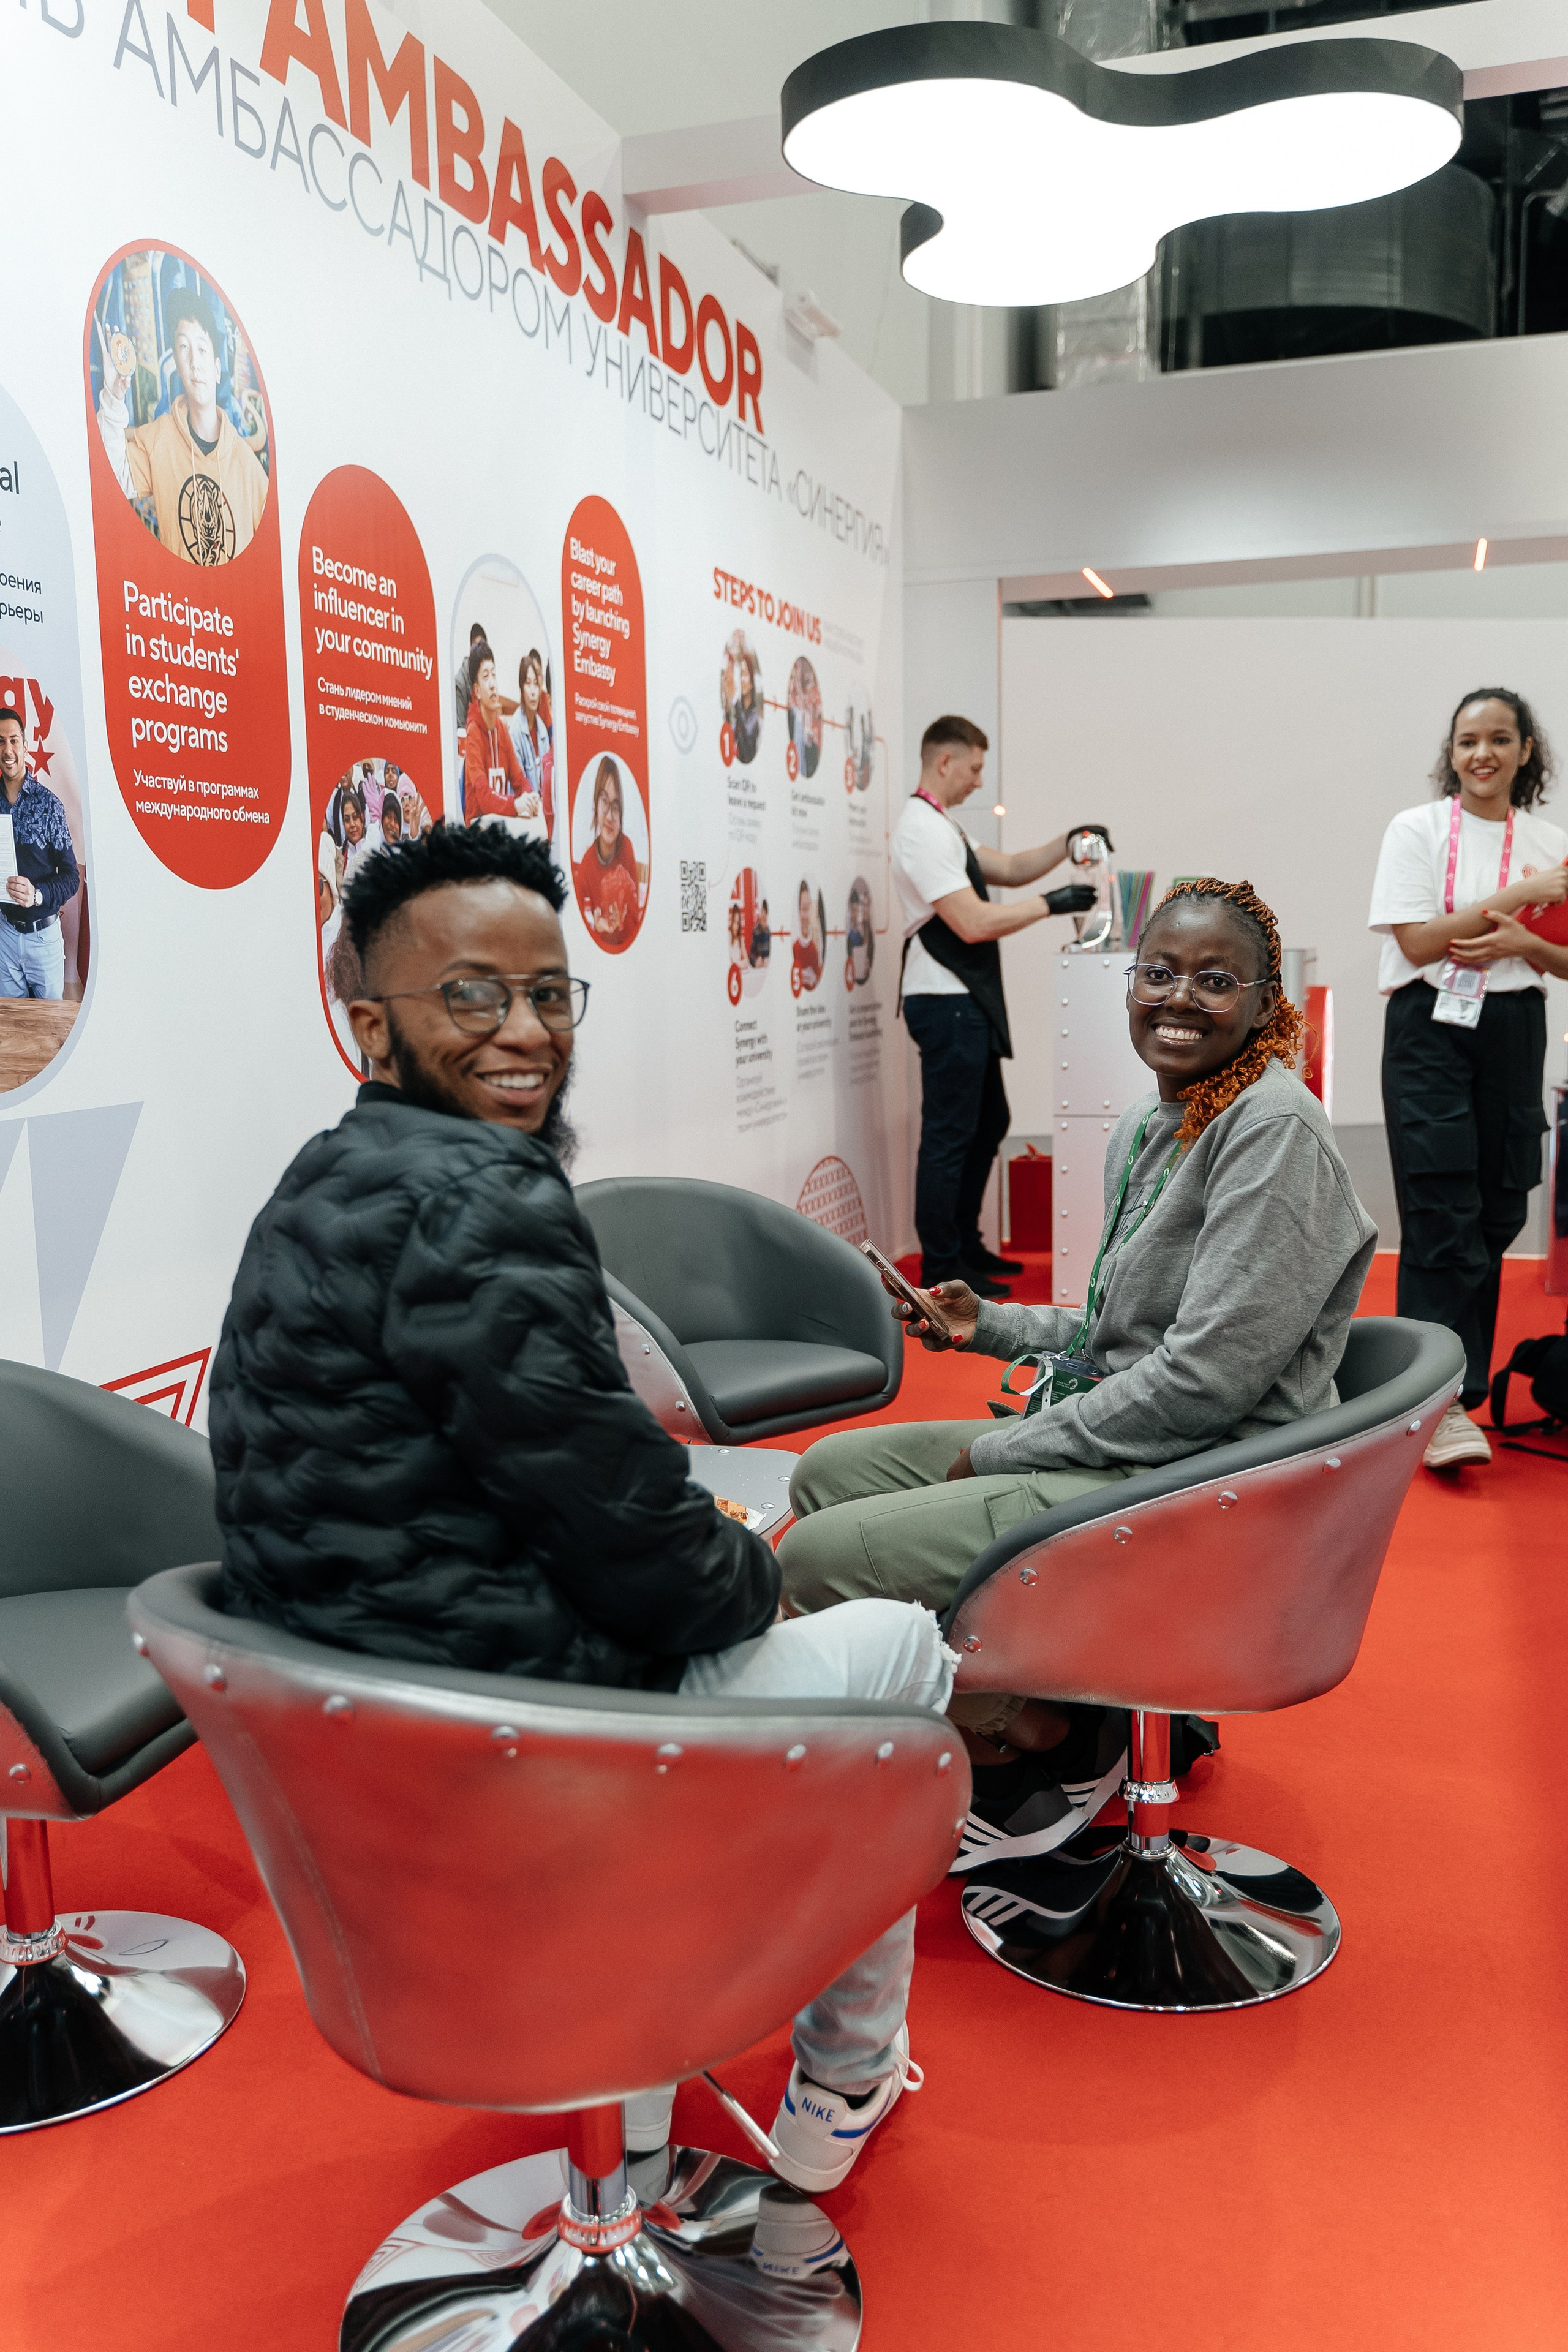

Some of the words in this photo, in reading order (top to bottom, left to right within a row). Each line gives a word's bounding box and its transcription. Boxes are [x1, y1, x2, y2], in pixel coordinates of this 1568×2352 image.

[259, 0, 765, 435] AMBASSADOR
[113, 0, 571, 364] АМБАССАДОРОМ
[583, 313, 783, 502] УНИВЕРСИТЕТА
[312, 545, 377, 592] Become
[379, 576, 397, 598] an
[570, 537, 595, 568] Blast
[594, 553, 616, 576] your
[570, 571, 601, 597] career
[601, 583, 624, 606] path
[714, 567, 755, 616] STEPS
[757, 588, 774, 623] TO
[777, 598, 805, 639] JOIN
[806, 612, 822, 646] US
[124, 580, 234, 636] Participate
[314, 583, 390, 630] influencer
[391, 606, 404, 635] in
[571, 593, 585, 623] by
[585, 598, 630, 640] launching
[126, 624, 146, 657] in
[149, 633, 239, 677] students'
[315, 627, 352, 654] your
[353, 637, 433, 680] community
[572, 622, 611, 660] Synergy
[573, 649, 616, 687] Embassy
[128, 673, 228, 719] exchange
[317, 676, 344, 696] Стань
[345, 686, 382, 705] лидером
[382, 695, 412, 710] мнений
[131, 717, 228, 753] programs
[318, 703, 325, 715] в
[325, 704, 384, 726] студенческом
[385, 716, 428, 734] комьюнити
[724, 731, 729, 758] 1
[788, 748, 796, 774] 2
[133, 769, 186, 794] Участвуй
[188, 780, 195, 792] в
[196, 781, 259, 799] программах
[135, 800, 231, 821] международного
[232, 805, 270, 824] обмена
[730, 971, 739, 998] 6
[793, 967, 801, 991] 5
[801, 2097, 835, 2123] NIKE
